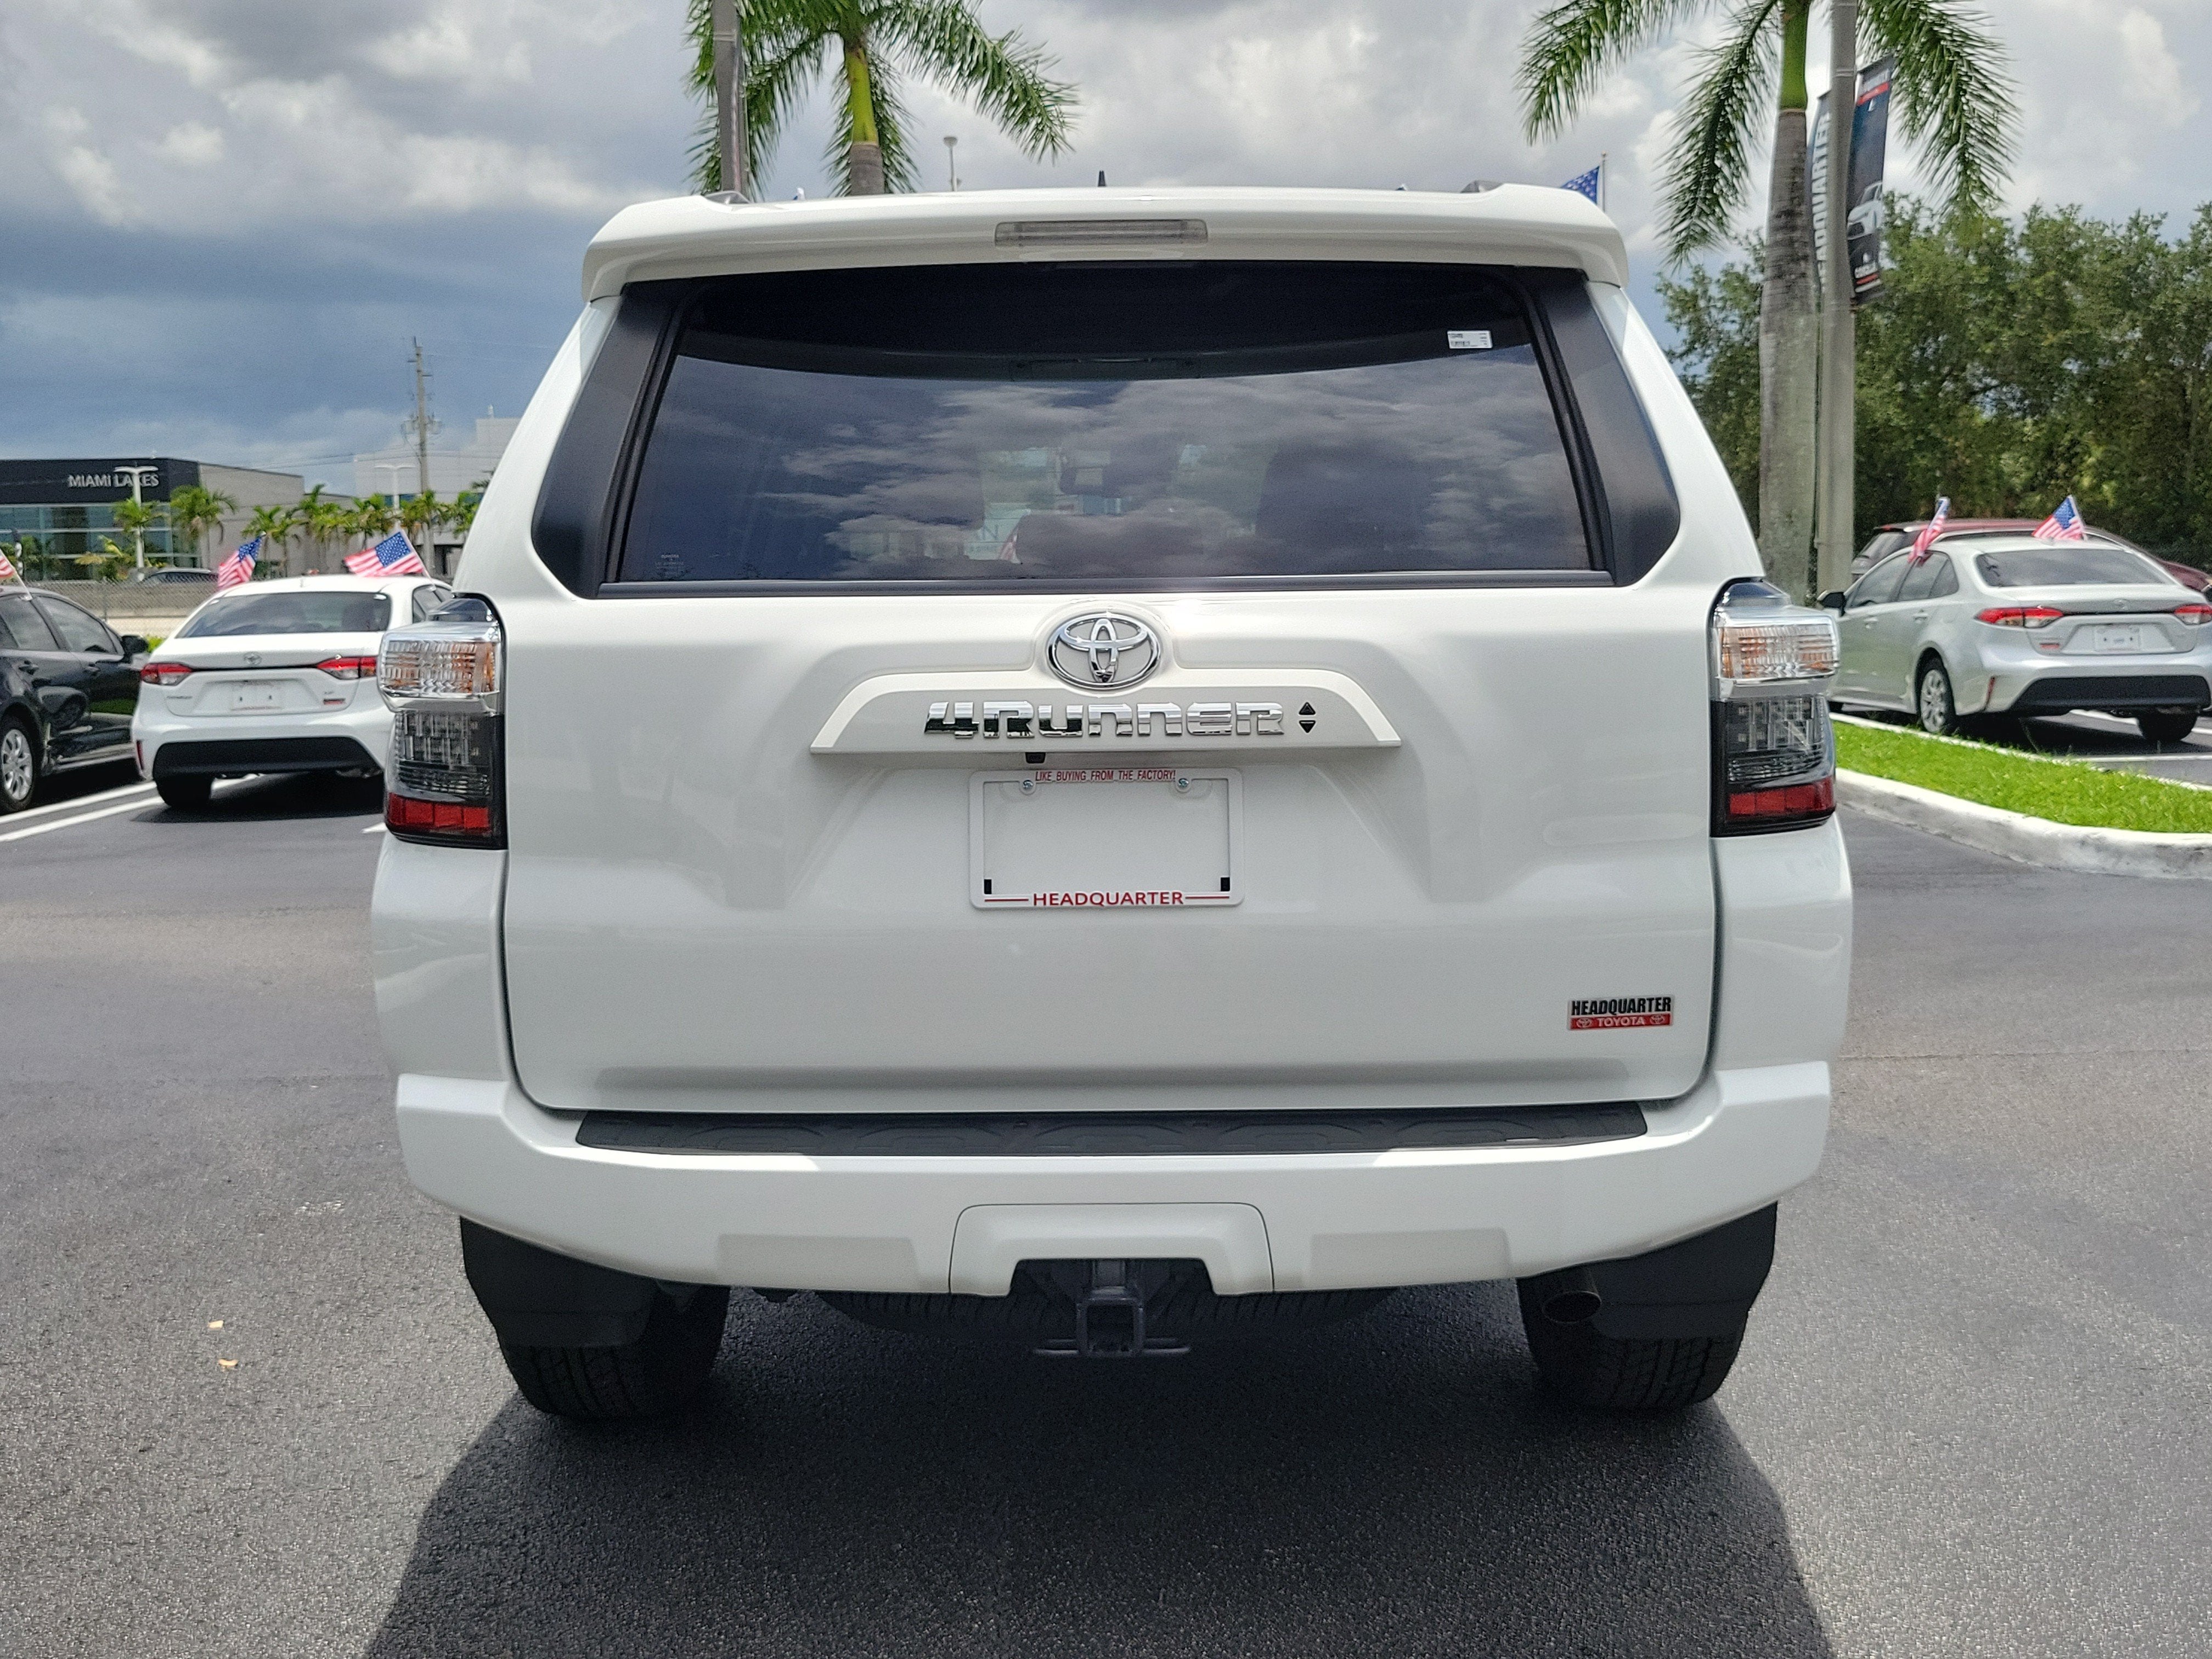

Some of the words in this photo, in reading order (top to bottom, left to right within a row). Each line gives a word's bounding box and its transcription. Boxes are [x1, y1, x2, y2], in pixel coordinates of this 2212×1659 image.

[1812, 112, 1830, 294] EADQUARTER
[67, 474, 111, 487] MIAMI
[1035, 771, 1052, 781] LIKE
[1056, 771, 1086, 781] BUYING
[1091, 771, 1114, 781] FROM
[1119, 770, 1133, 780] THE
[1137, 770, 1176, 780] FACTORY!
[1034, 891, 1183, 907] HEADQUARTER
[1571, 996, 1672, 1016] HEADQUARTER
[1597, 1016, 1645, 1027] TOYOTA
